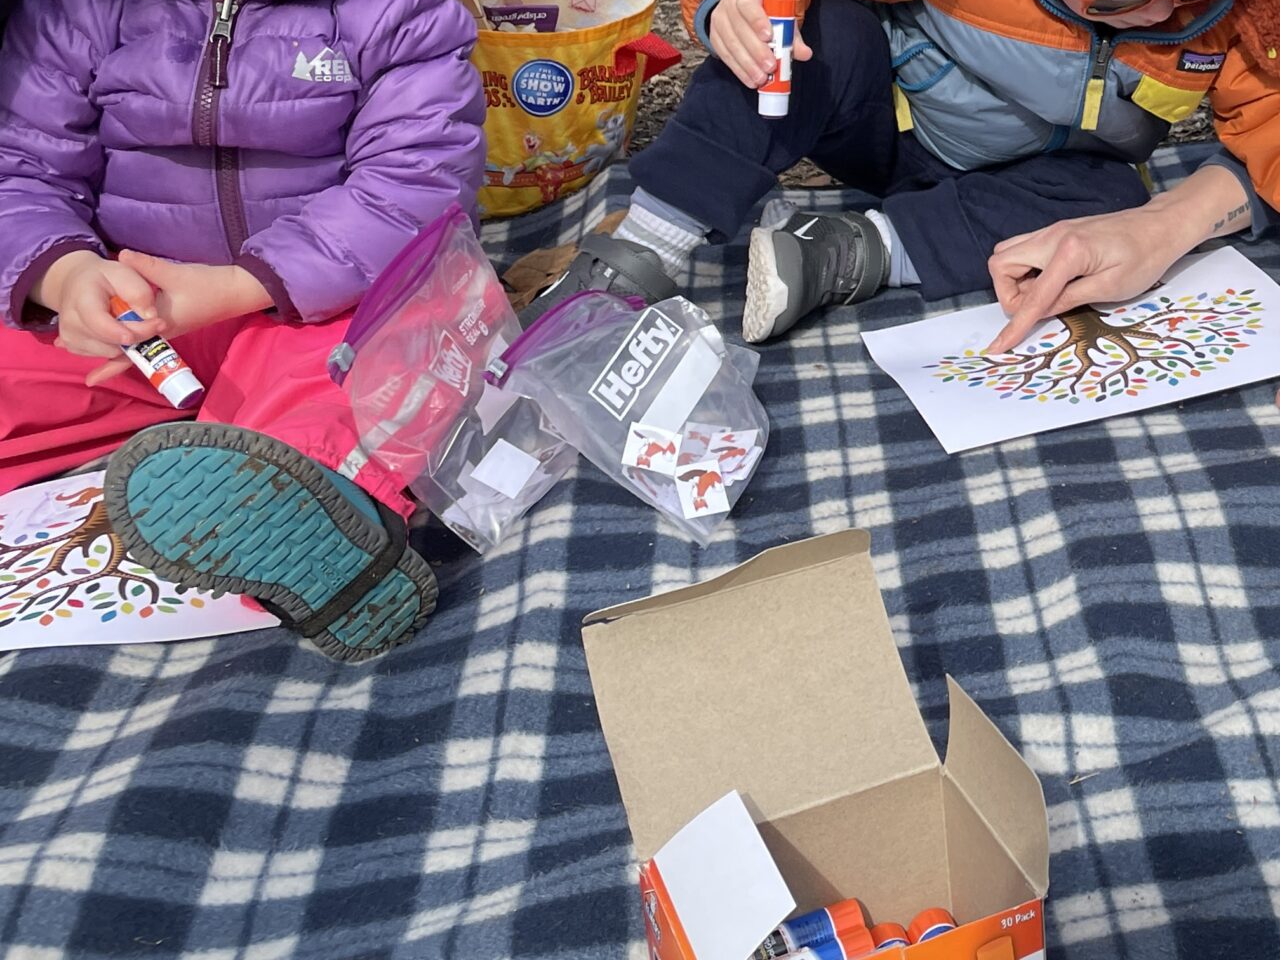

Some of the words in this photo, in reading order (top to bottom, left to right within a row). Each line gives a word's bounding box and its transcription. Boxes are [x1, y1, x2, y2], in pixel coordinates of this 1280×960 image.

[520, 78, 566, 93] SHOW
[590, 79, 634, 105] BAILEY
[521, 93, 561, 106] EARTH
[598, 317, 677, 410] Hefty
[1000, 917, 1013, 929] 30
[1015, 909, 1036, 925] Pack
